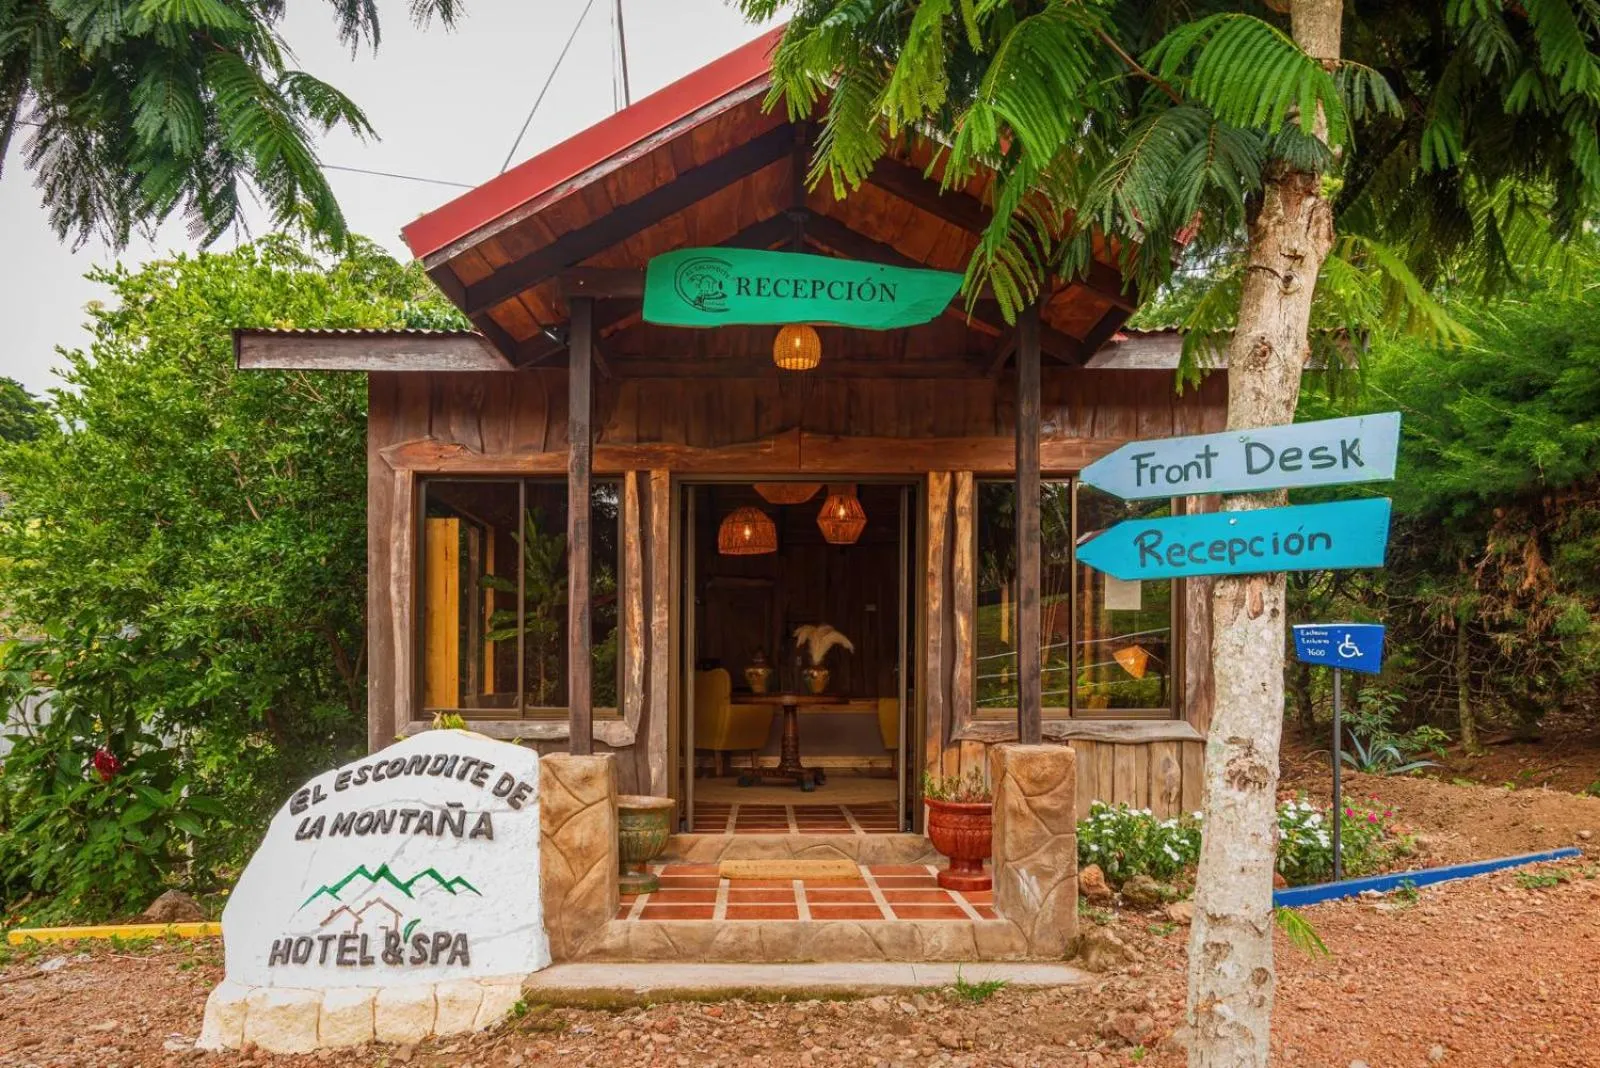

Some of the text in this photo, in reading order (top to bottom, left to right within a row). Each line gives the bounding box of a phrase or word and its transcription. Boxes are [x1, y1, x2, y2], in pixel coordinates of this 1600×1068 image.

[735, 276, 899, 303] RECEPCIÓN
[1130, 443, 1218, 487] Front
[1133, 525, 1332, 568] Recepción
[289, 753, 534, 816] EL ESCONDITE DE
[295, 802, 495, 841] LA MONTAÑA
[268, 931, 375, 967] HOTEL
